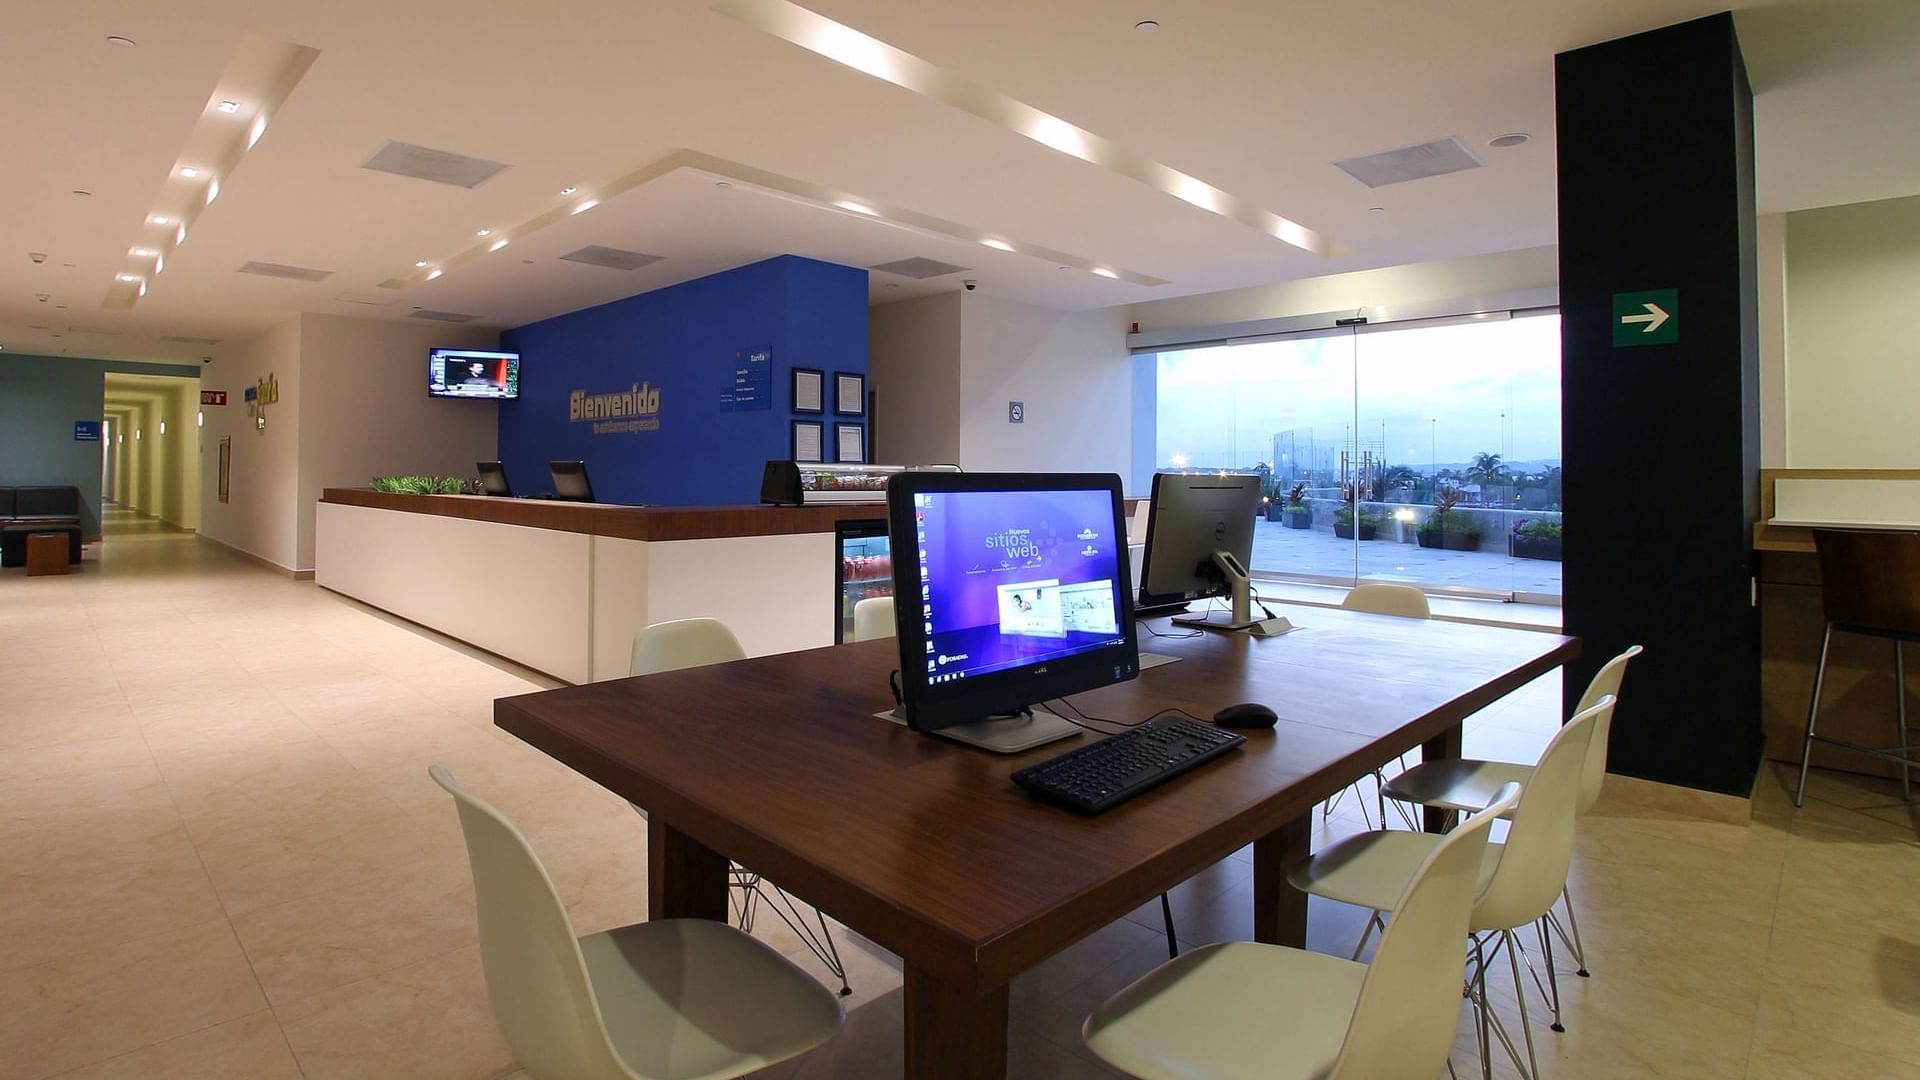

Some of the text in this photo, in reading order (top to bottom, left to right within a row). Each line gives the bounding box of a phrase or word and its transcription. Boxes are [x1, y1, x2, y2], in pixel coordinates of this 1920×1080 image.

[570, 382, 660, 422] Bienvenido
[985, 531, 1028, 548] sitios
[1006, 541, 1039, 559] web
